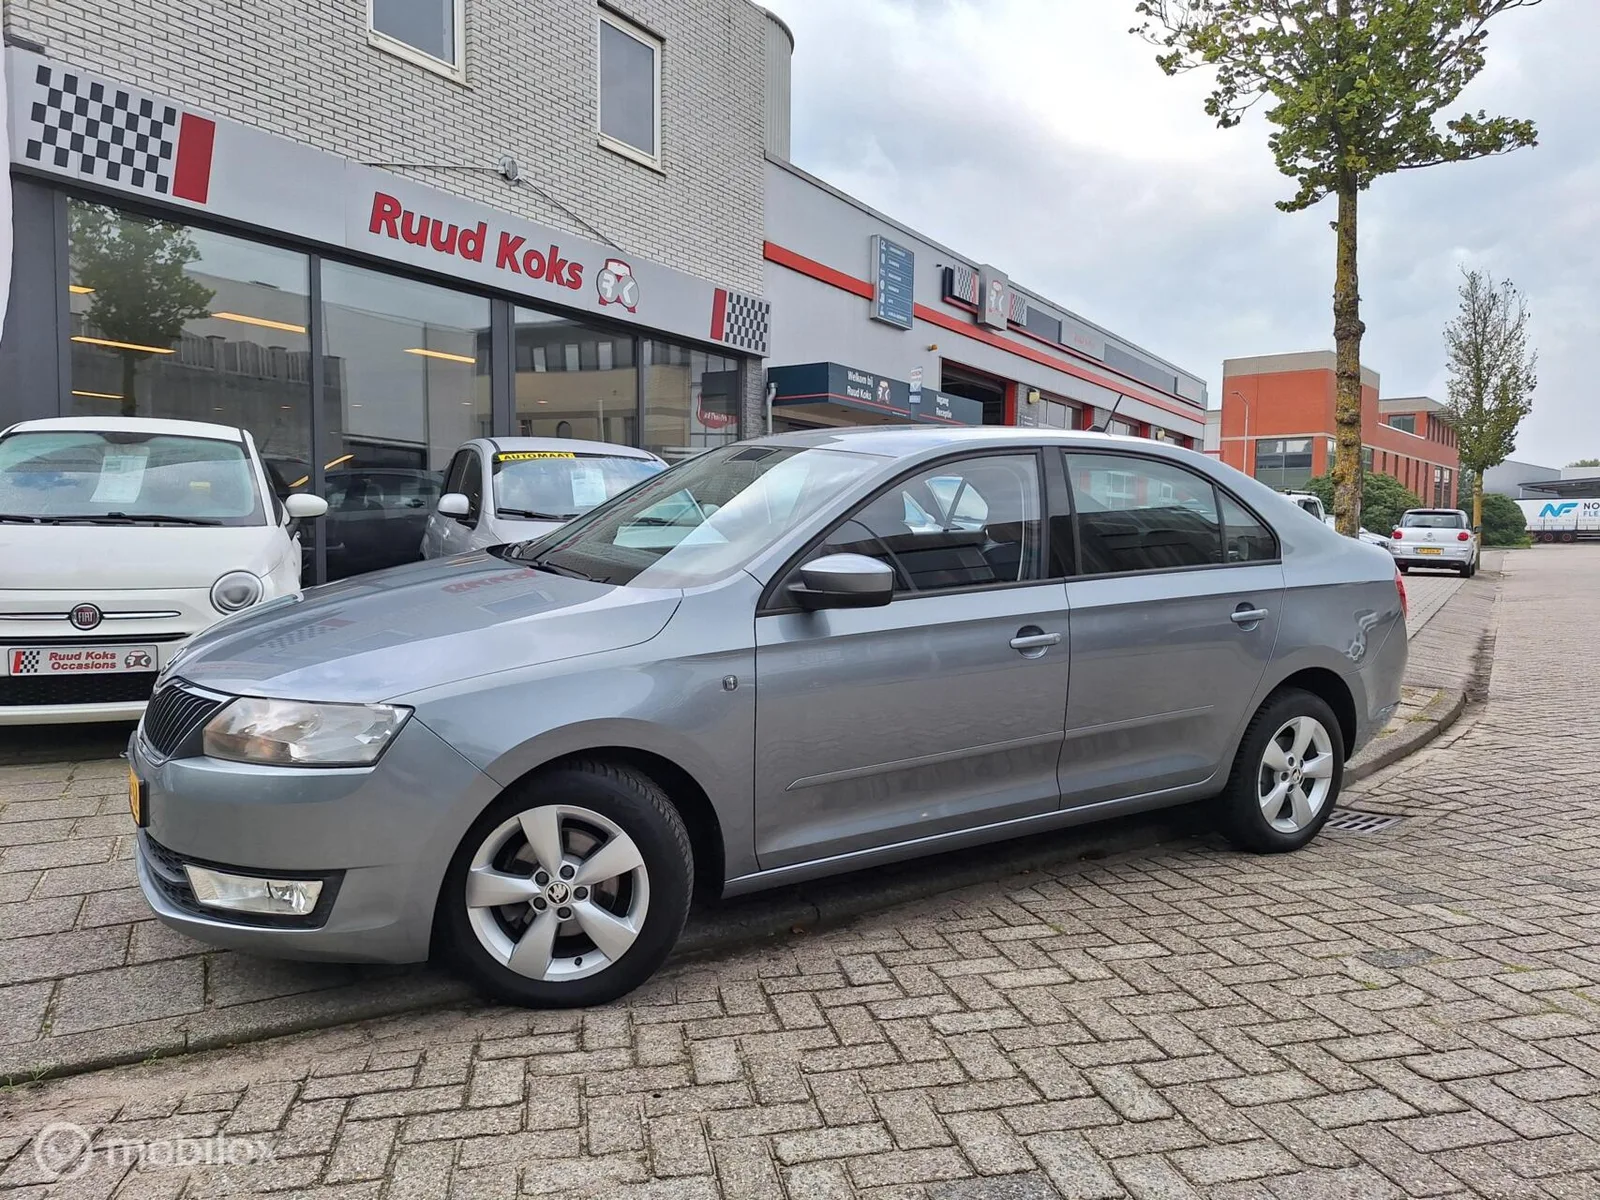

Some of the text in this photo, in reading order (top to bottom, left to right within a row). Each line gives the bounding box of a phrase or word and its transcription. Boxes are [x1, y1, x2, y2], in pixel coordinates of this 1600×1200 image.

[369, 191, 584, 291] Ruud Koks
[847, 370, 867, 384] Welkom
[847, 385, 872, 400] Ruud Koks
[78, 611, 94, 623] FIAT
[49, 651, 117, 661] Ruud Koks
[51, 660, 117, 671] Occasions
